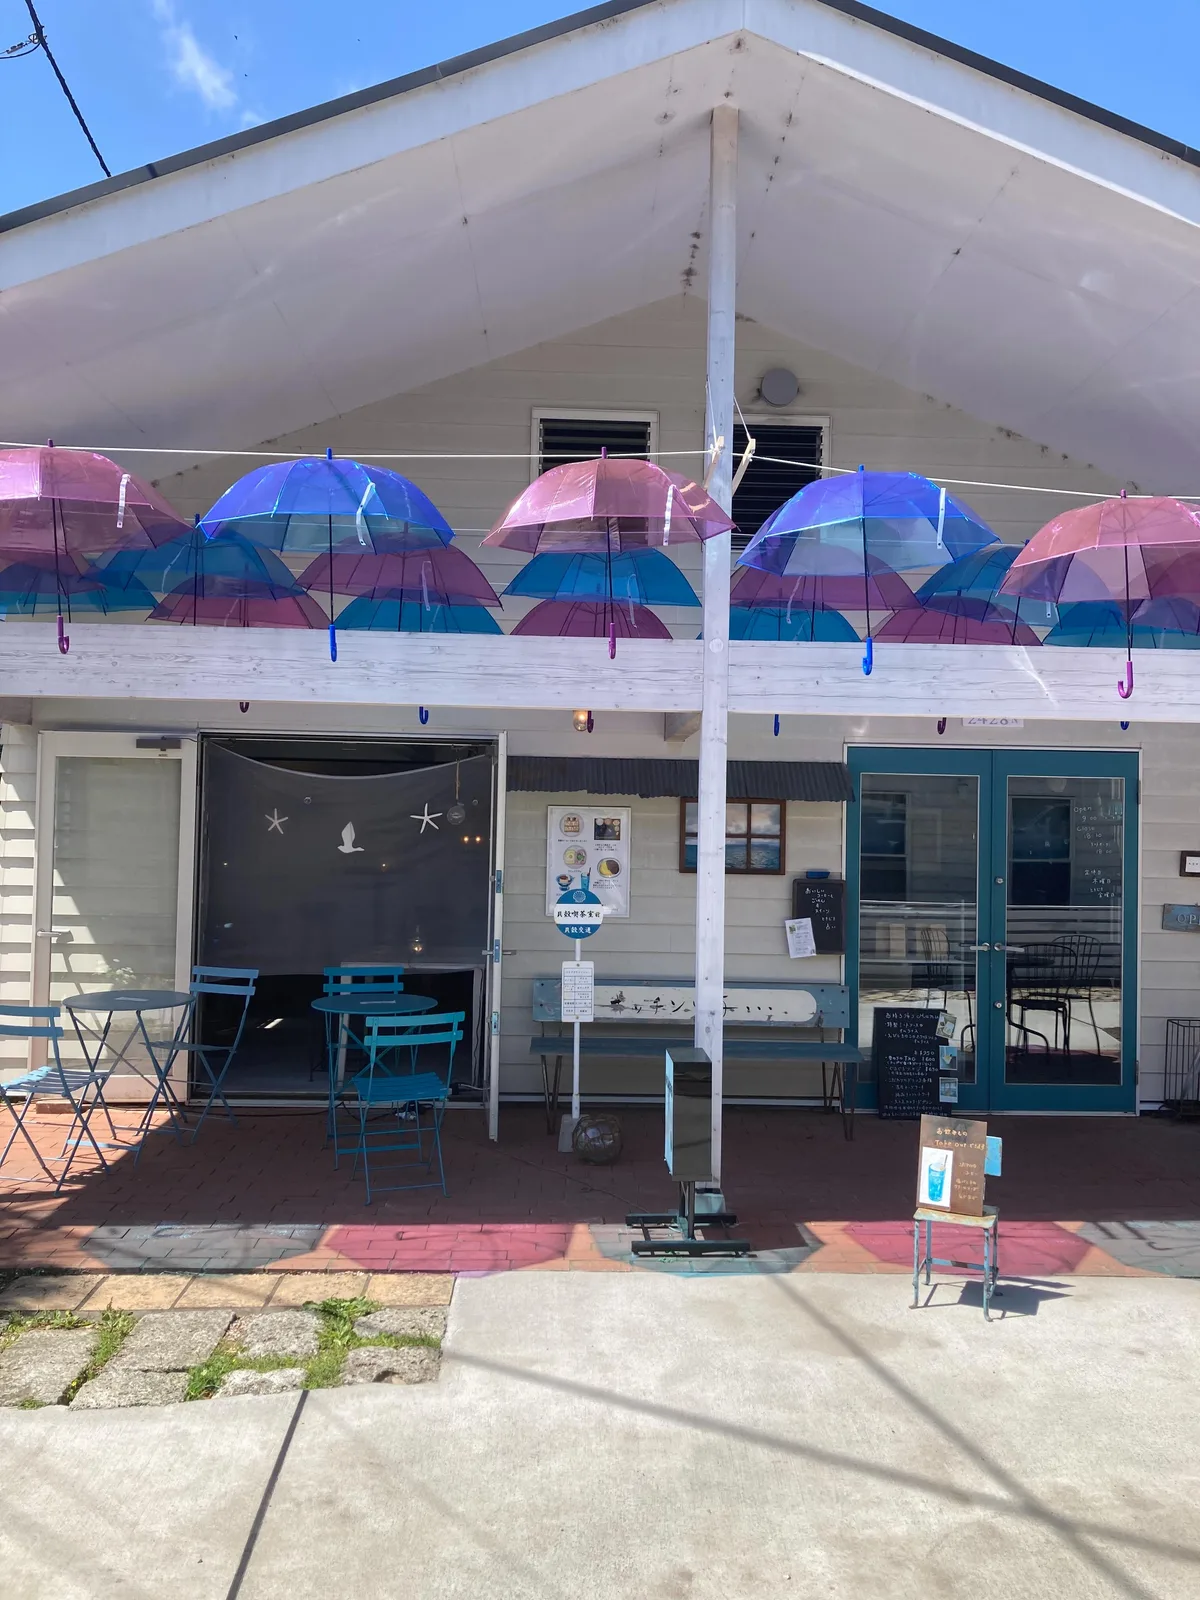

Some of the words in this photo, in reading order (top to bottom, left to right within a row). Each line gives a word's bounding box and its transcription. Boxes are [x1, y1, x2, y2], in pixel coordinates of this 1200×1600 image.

[1073, 806, 1092, 814] Open
[805, 887, 825, 895] おいしい
[1177, 913, 1200, 926] OP
[564, 926, 592, 934] 貝殻交通
[934, 1139, 952, 1147] Take
